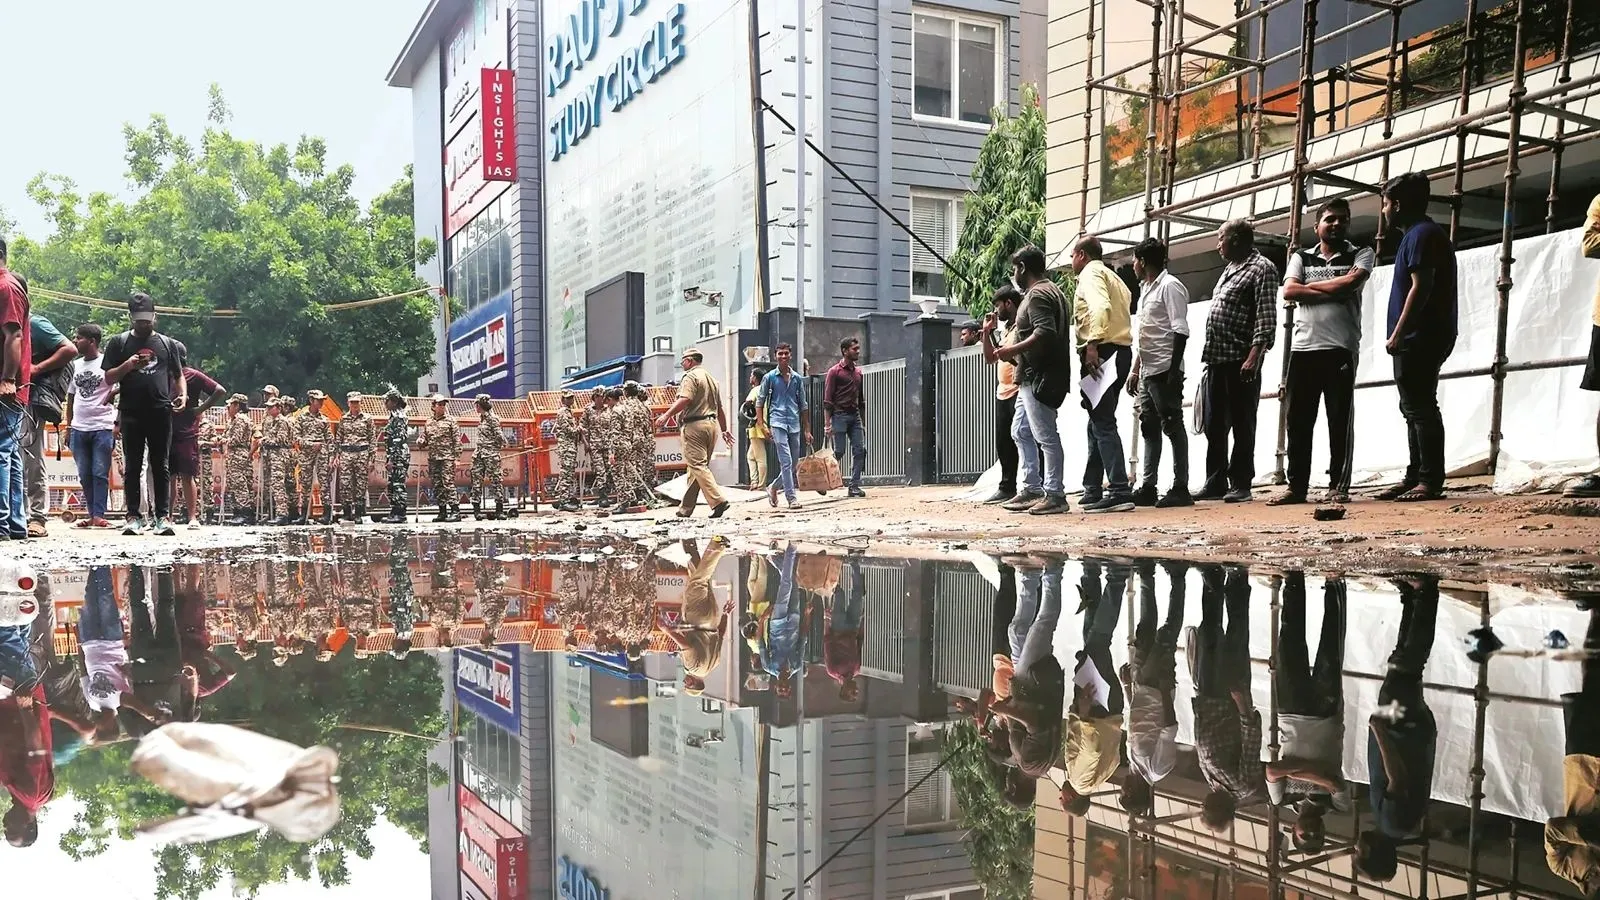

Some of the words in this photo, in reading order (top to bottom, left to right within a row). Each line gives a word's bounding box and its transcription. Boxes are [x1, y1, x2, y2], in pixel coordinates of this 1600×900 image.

[492, 72, 504, 161] INSIGHTS
[549, 75, 604, 161] STUDY
[603, 3, 685, 112] CIRCLE
[488, 166, 512, 176] IAS
